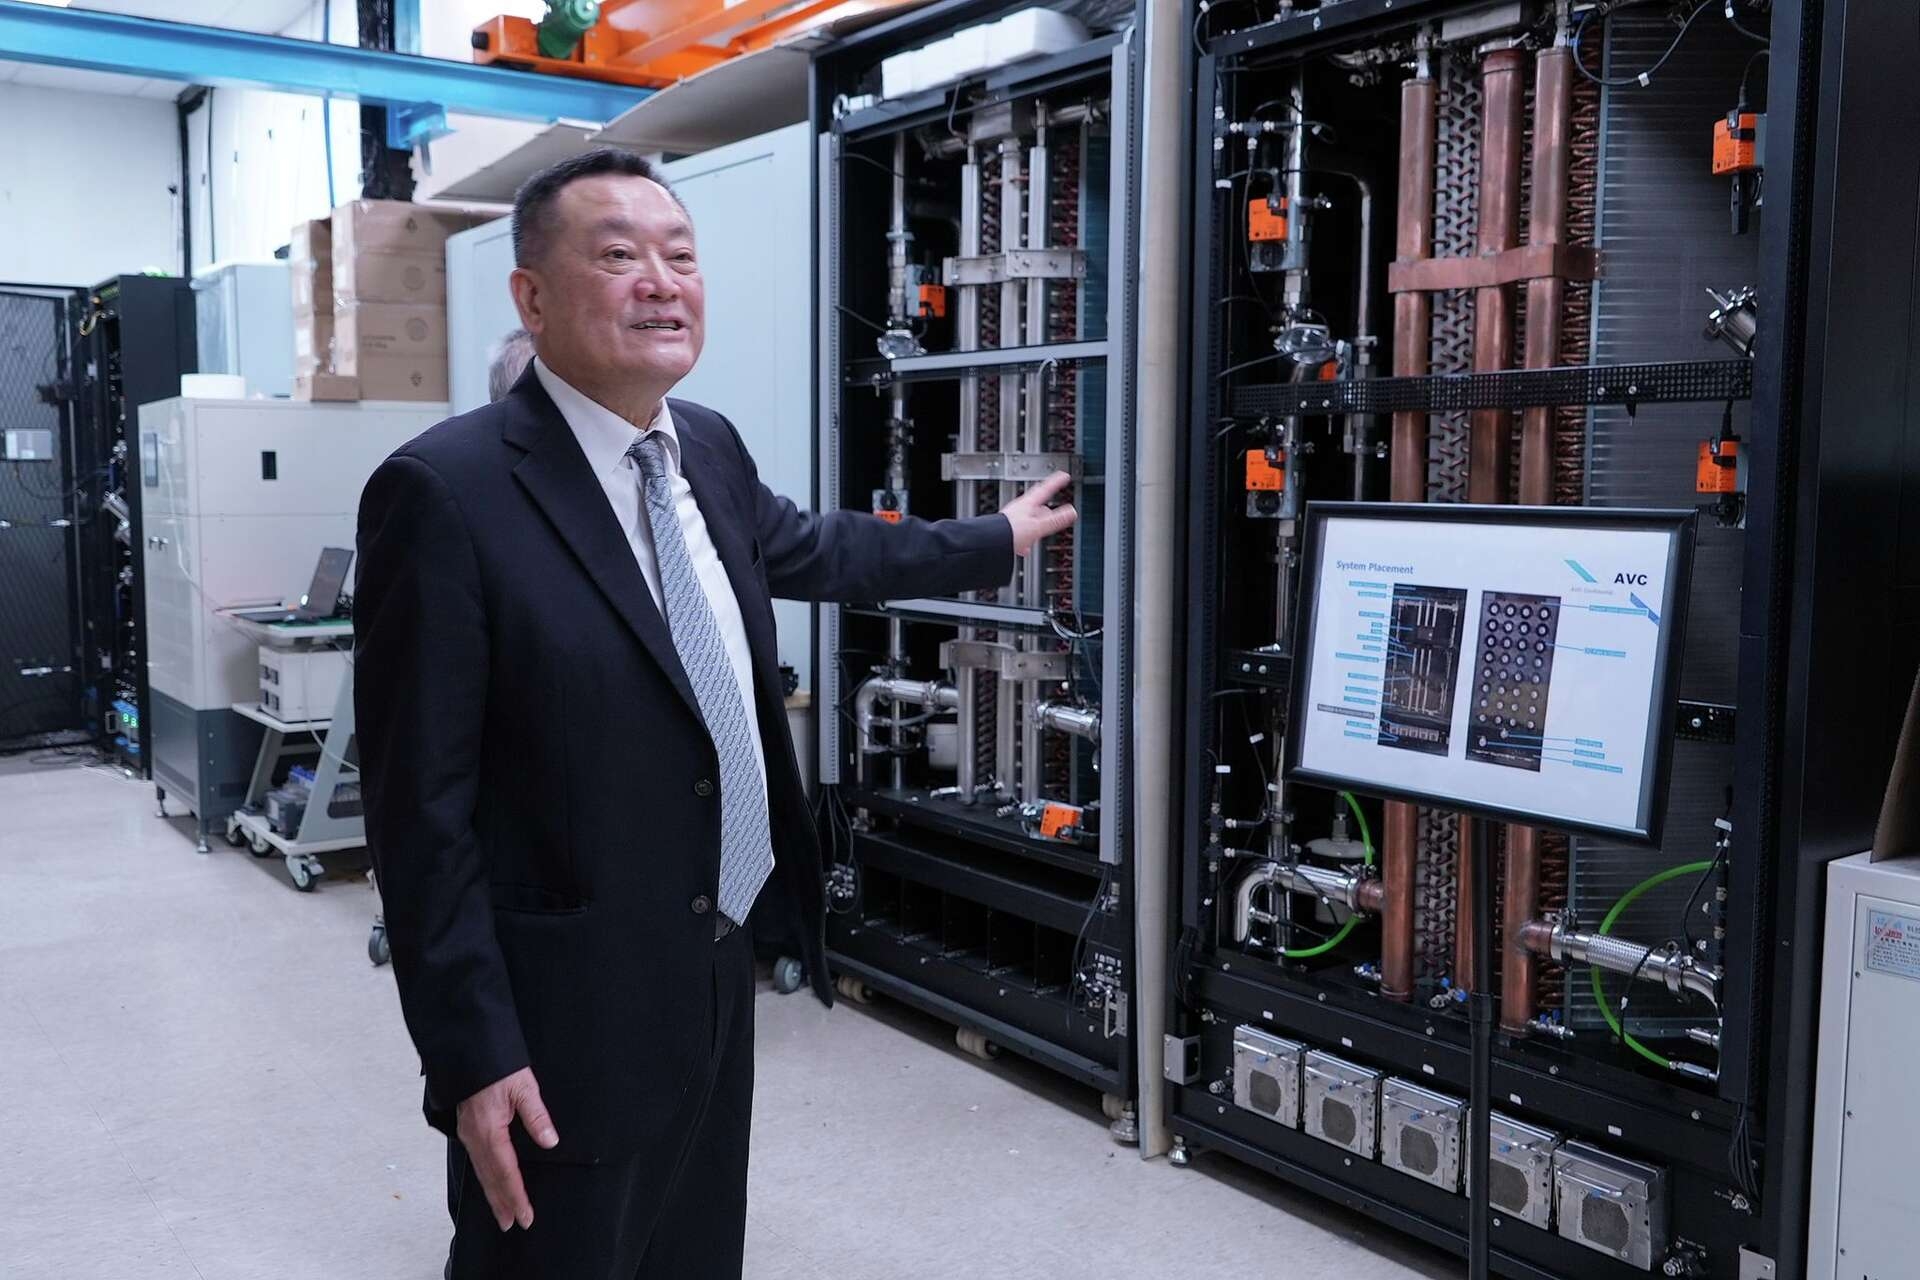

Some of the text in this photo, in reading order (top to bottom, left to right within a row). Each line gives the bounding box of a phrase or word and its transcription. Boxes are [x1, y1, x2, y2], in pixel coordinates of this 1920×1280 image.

[1336, 560, 1414, 575] System Placement
[1614, 572, 1648, 586] AVC
